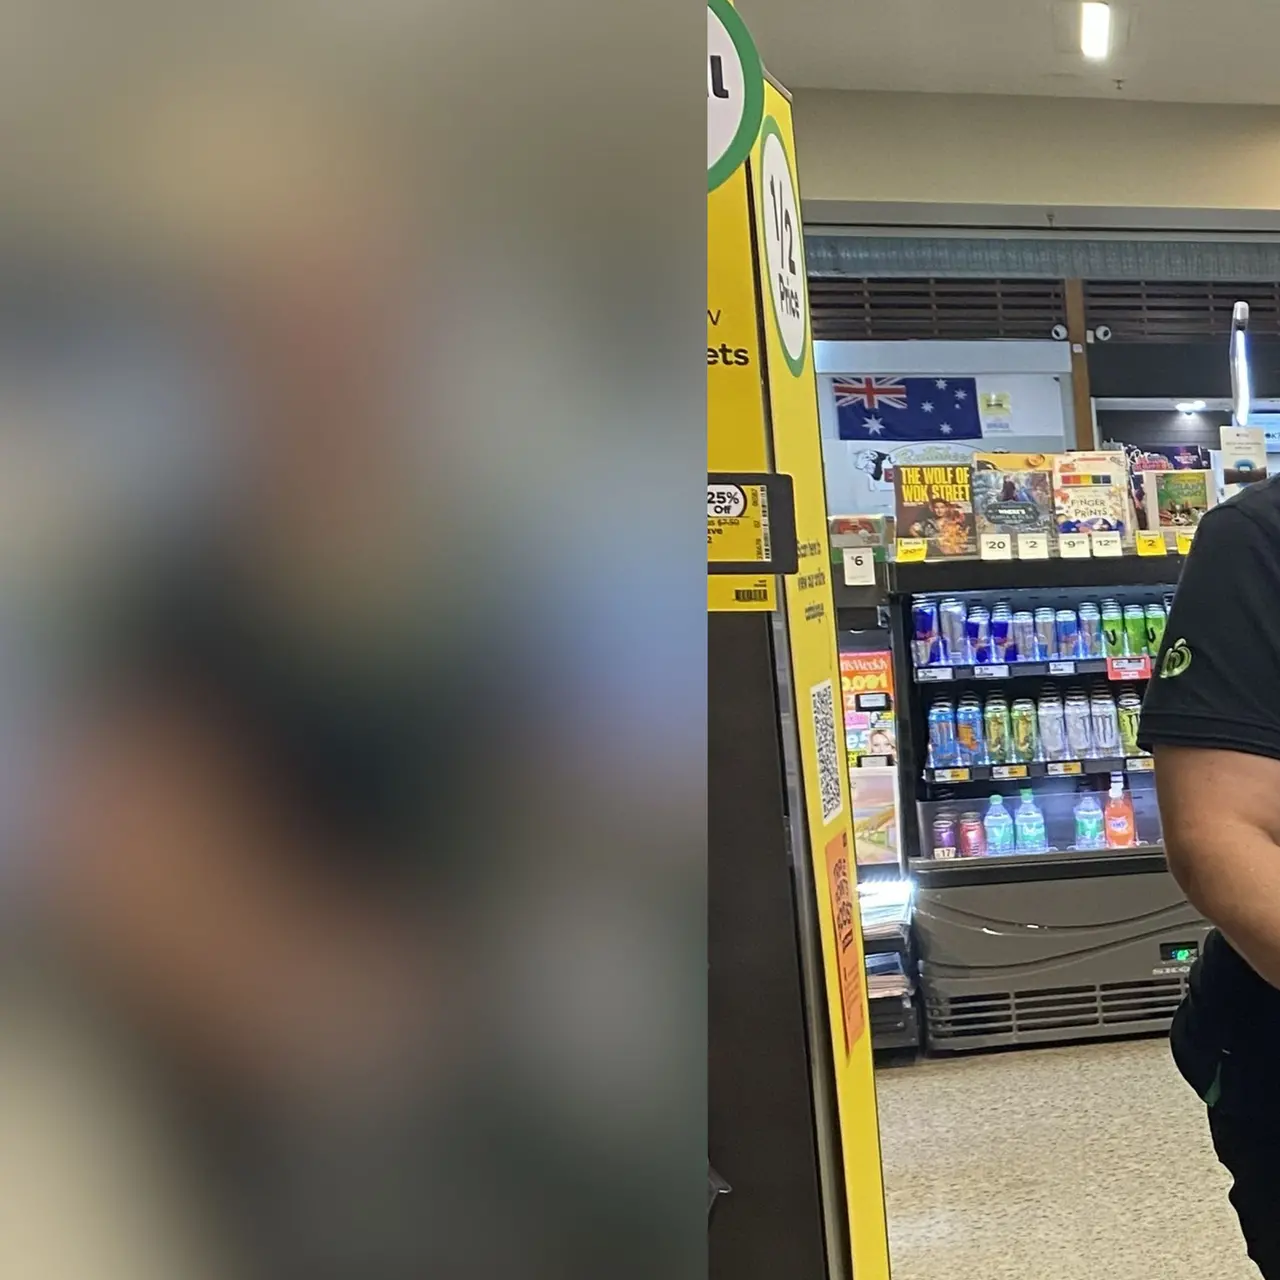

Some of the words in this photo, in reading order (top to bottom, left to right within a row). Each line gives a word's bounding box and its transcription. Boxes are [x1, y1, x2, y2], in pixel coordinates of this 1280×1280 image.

[778, 272, 800, 320] Price
[900, 466, 921, 484] THE
[922, 466, 953, 485] WOLF
[956, 466, 970, 484] OF
[902, 484, 930, 502] WOK
[932, 484, 971, 501] STREET
[1070, 498, 1106, 507] FINGER
[1074, 508, 1108, 517] PRINTS
